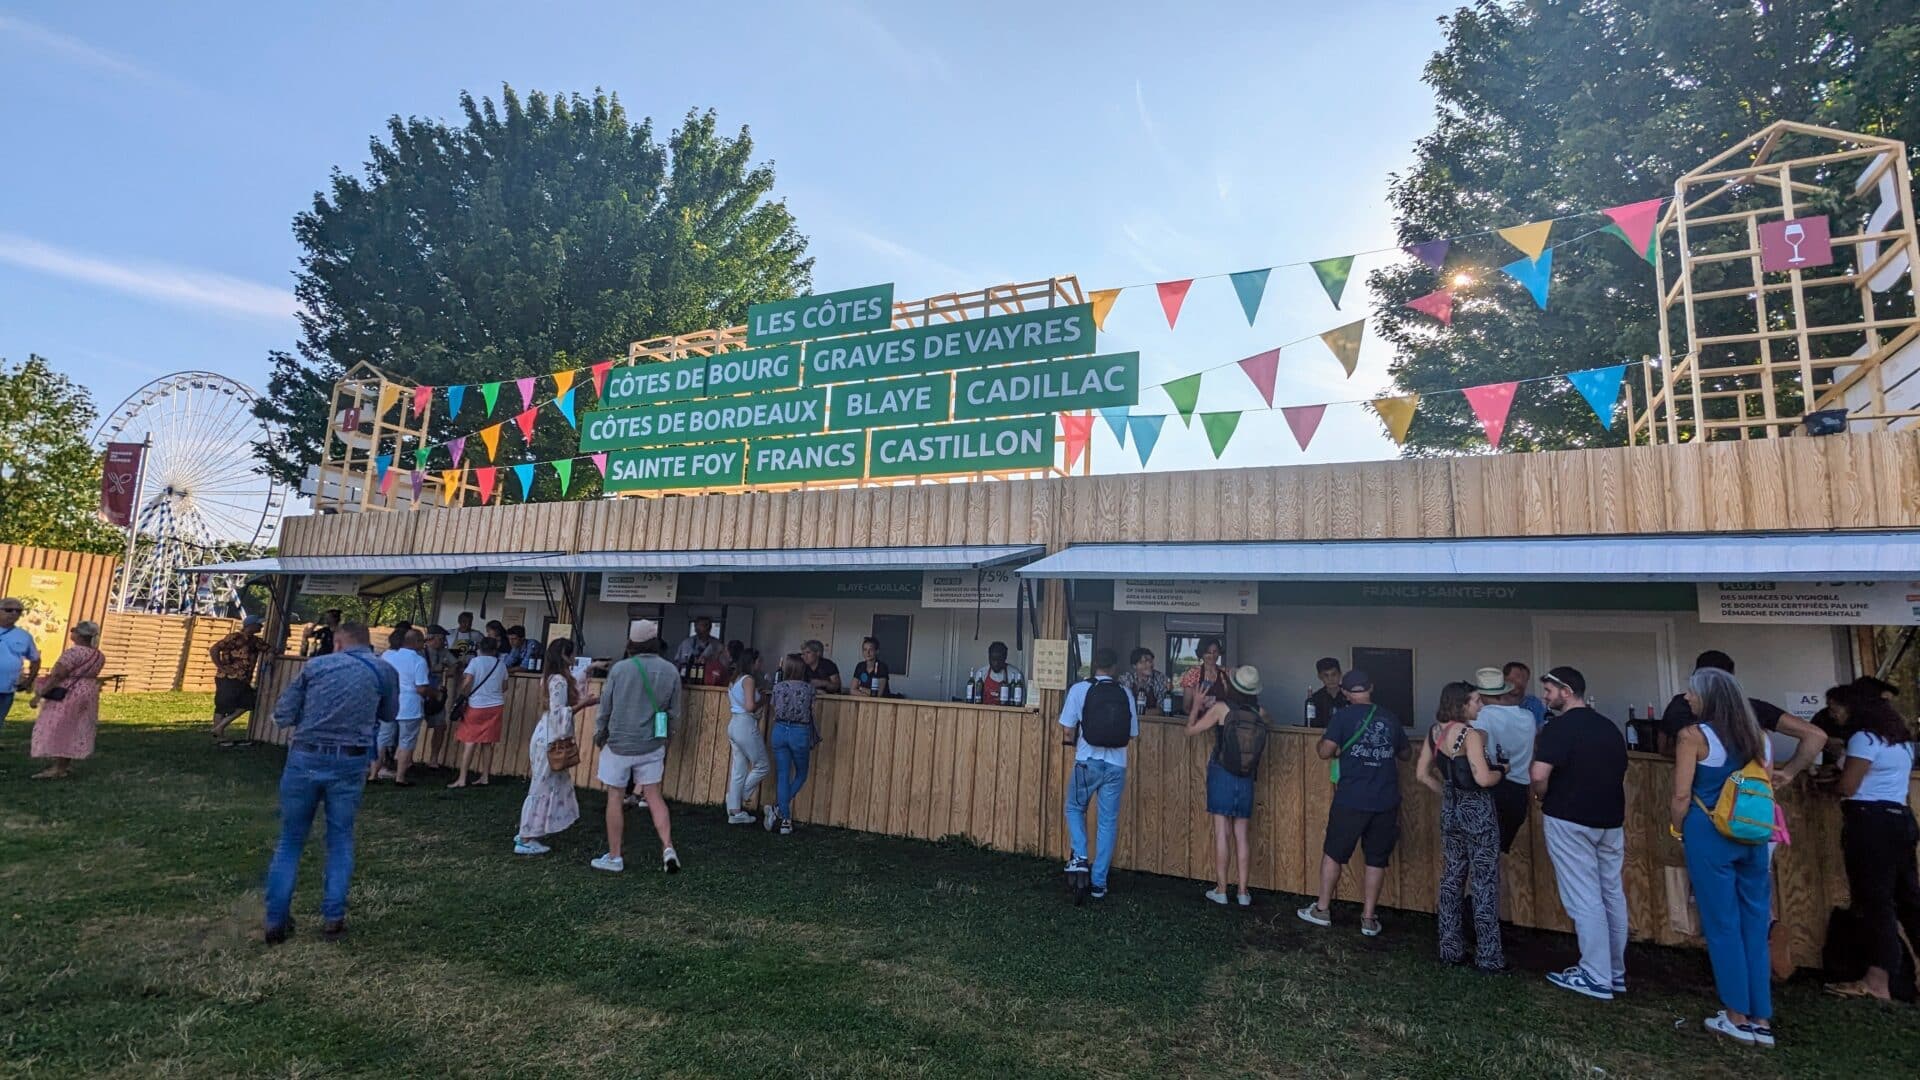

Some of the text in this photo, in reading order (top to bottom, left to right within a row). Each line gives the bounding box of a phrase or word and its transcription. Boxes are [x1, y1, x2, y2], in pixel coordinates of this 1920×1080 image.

[755, 298, 882, 337] LES CÔTES
[813, 316, 1082, 373] GRAVES DE VAYRES
[609, 355, 790, 399] CÔTES DE BOURG
[967, 364, 1126, 406] CADILLAC
[847, 386, 932, 418] BLAYE
[590, 399, 819, 441] CÔTES DE BORDEAUX
[756, 442, 857, 473] FRANCS
[879, 428, 1043, 465] CASTILLON
[611, 452, 738, 482] SAINTE FOY
[1721, 609, 1767, 617] DÉMARCHE
[1781, 602, 1829, 610] CERTIFIÉES
[1800, 695, 1819, 705] A5
